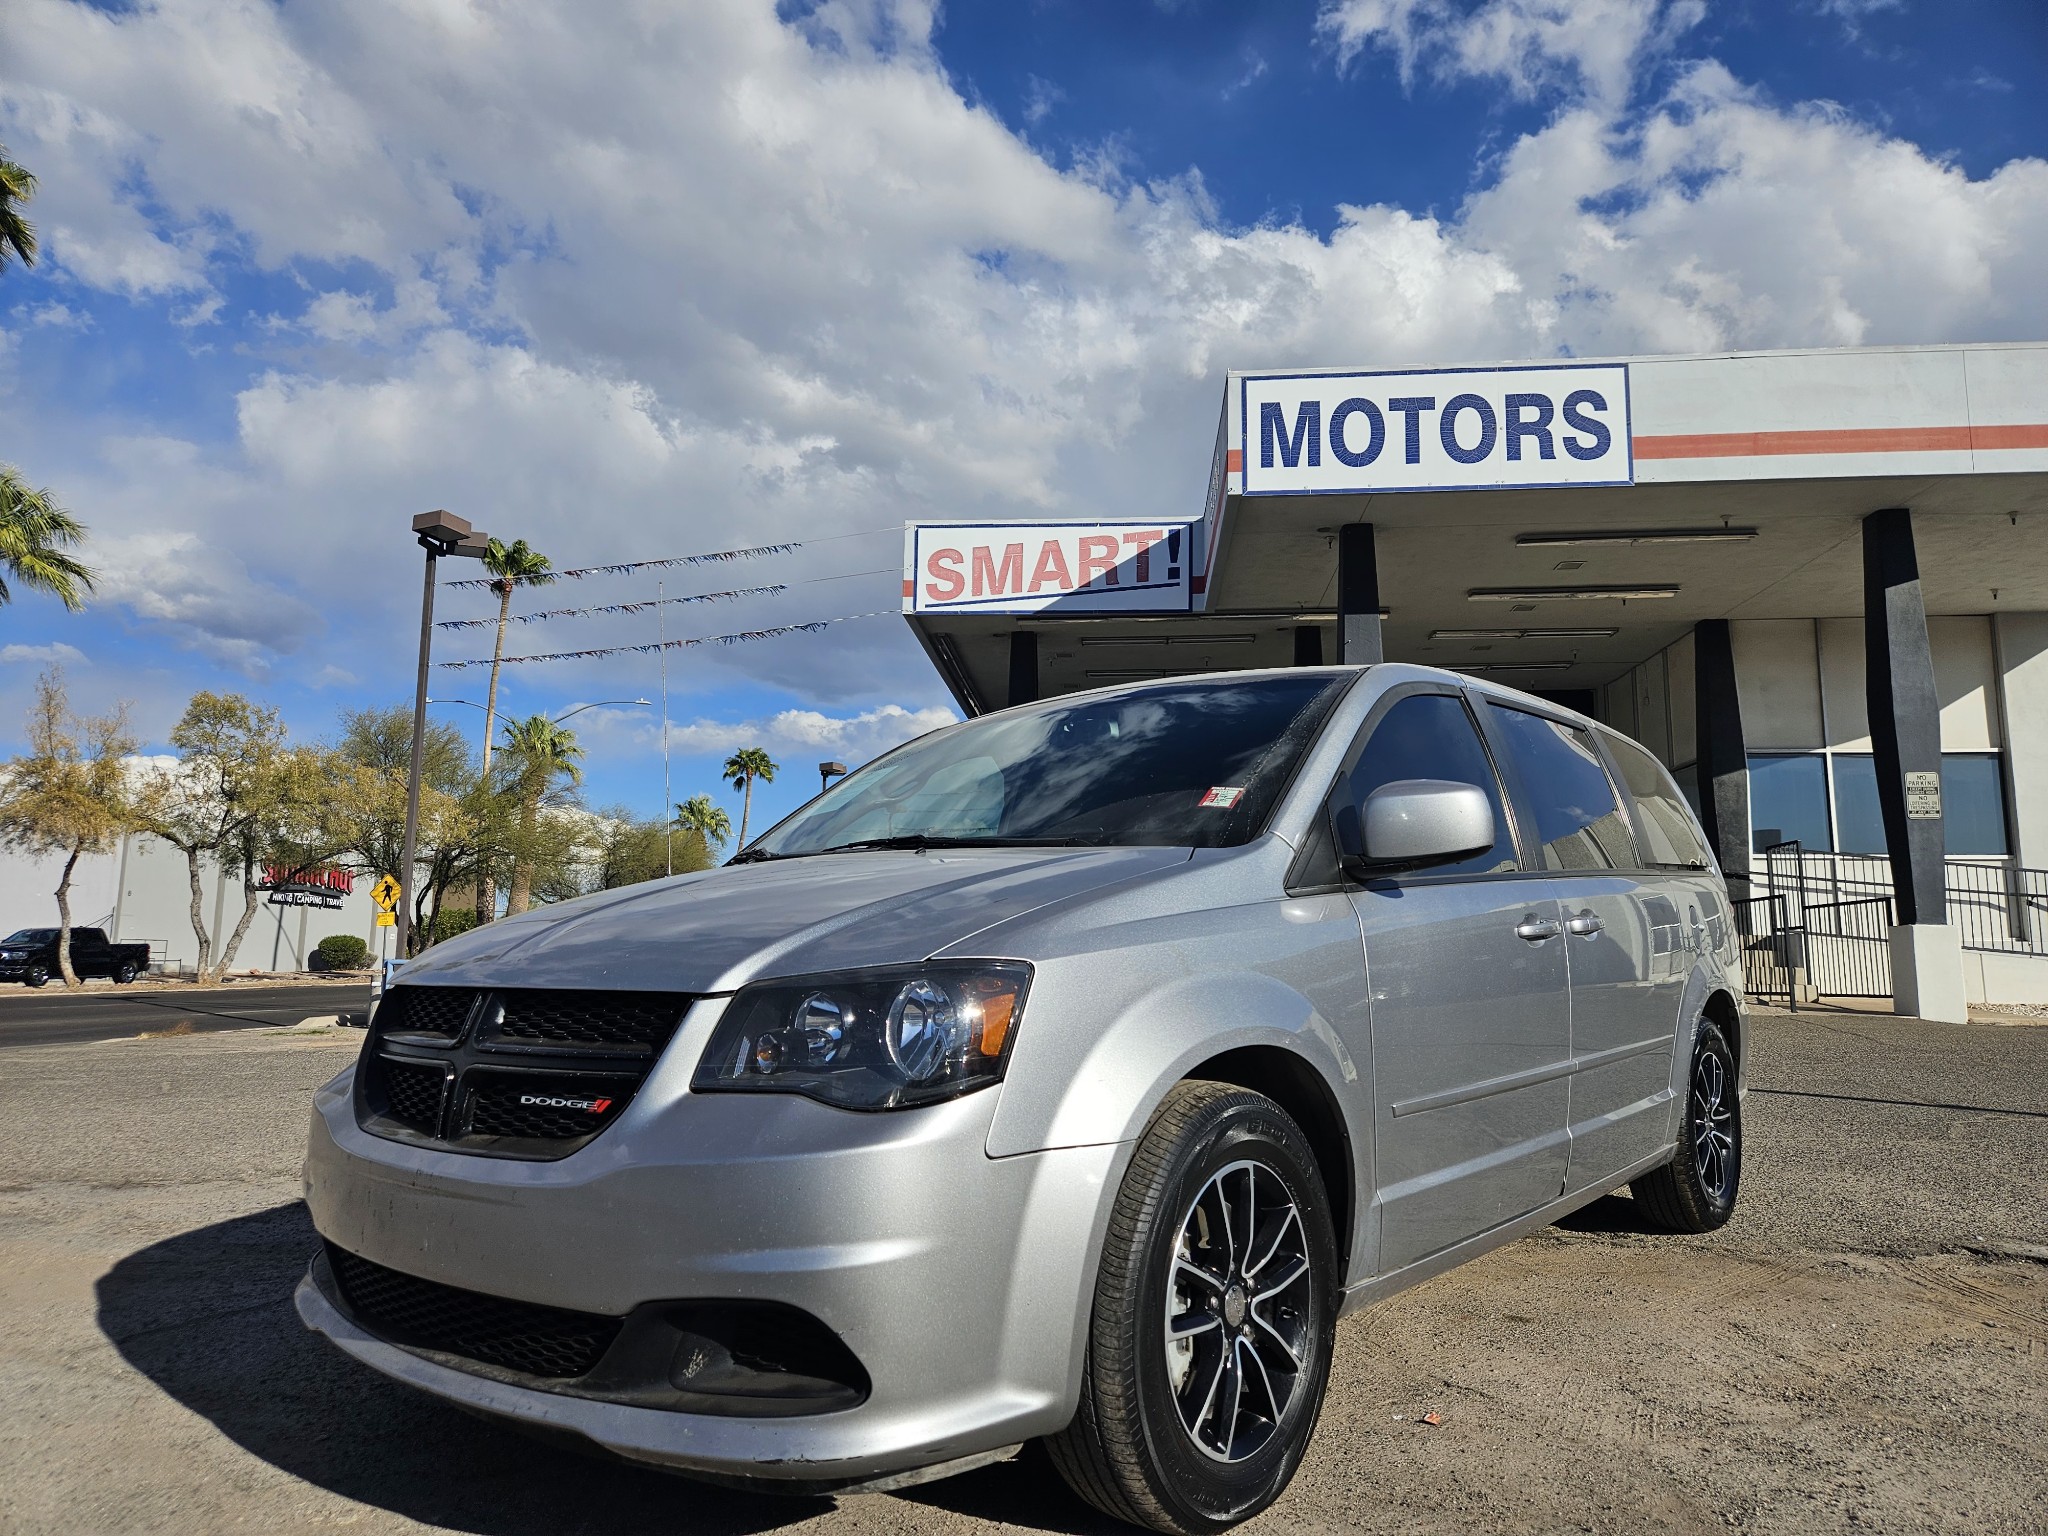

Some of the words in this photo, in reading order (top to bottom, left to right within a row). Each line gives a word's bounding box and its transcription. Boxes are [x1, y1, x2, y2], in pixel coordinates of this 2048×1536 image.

[1260, 389, 1611, 468] MOTORS
[925, 528, 1182, 602] SMART!
[272, 893, 293, 902] HIKING
[297, 894, 323, 905] CAMPING
[326, 897, 346, 907] TRAVEL
[520, 1095, 598, 1111] DODGE
